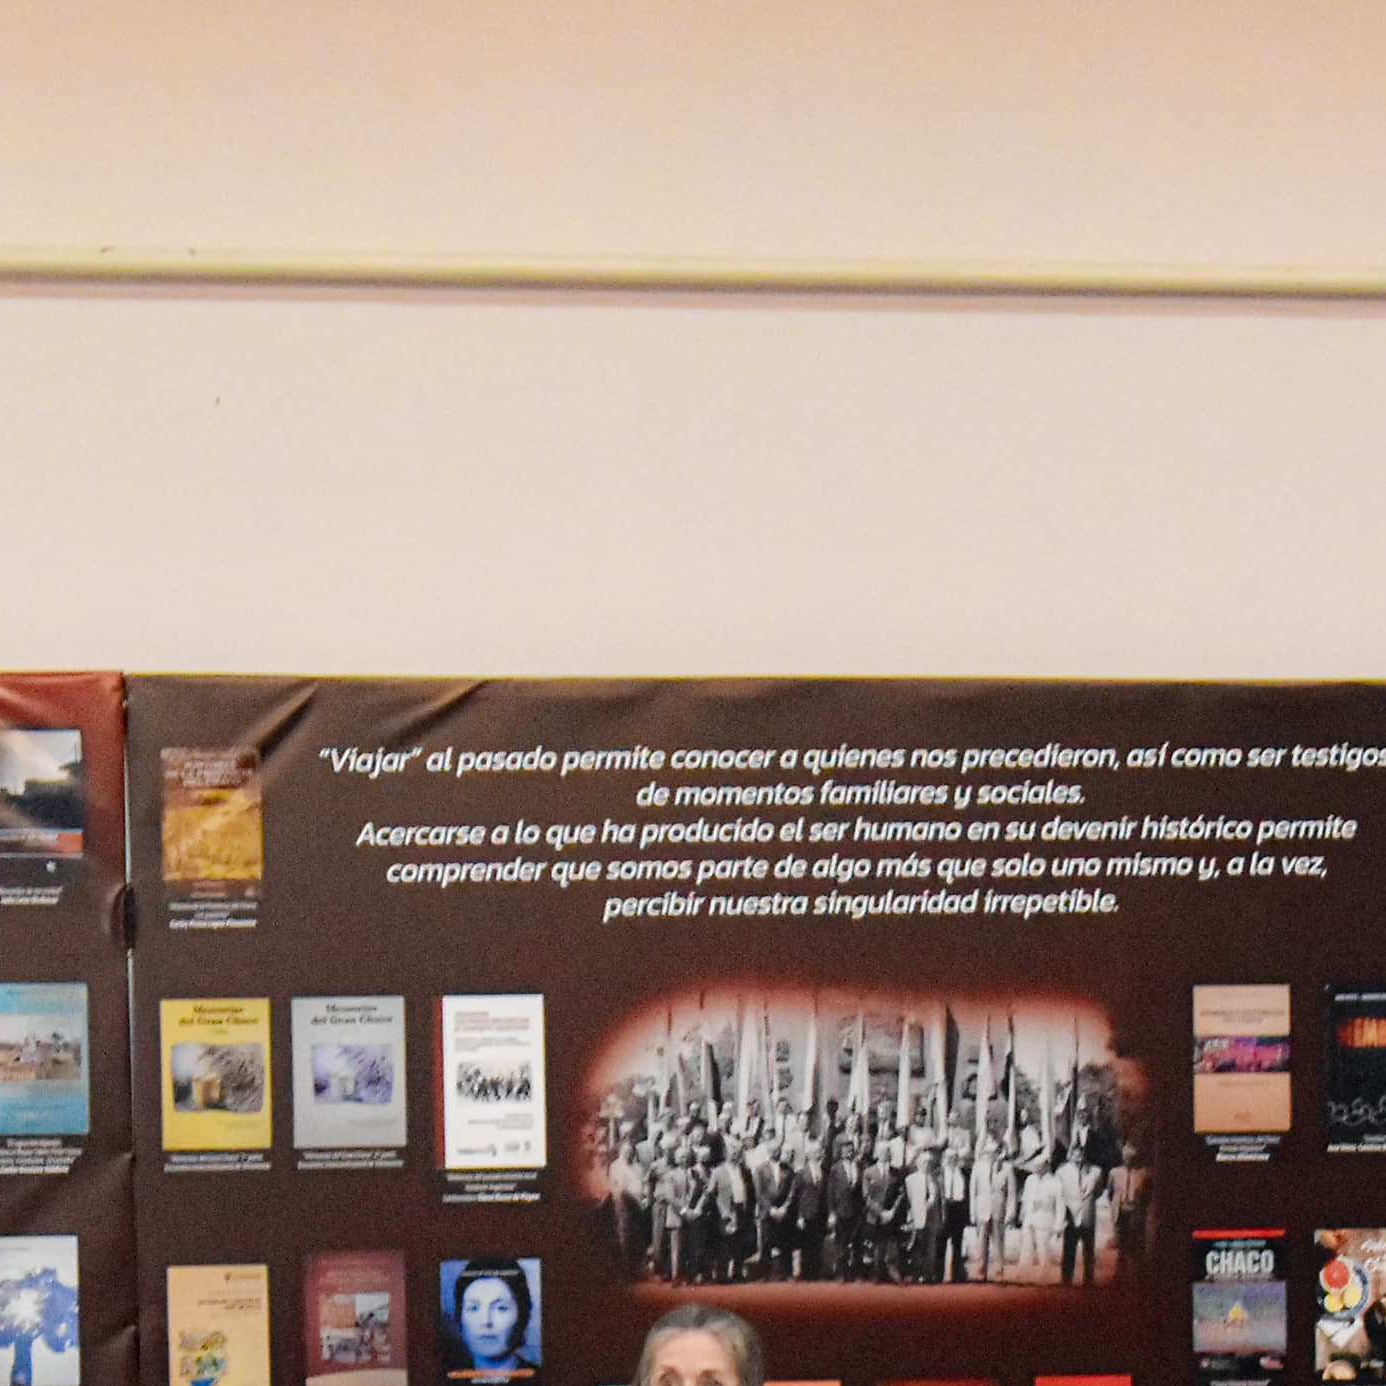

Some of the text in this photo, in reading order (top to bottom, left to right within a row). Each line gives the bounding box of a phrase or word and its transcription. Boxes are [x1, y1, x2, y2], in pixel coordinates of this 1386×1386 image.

[426, 747, 453, 771] al
[456, 745, 557, 778] pasado
[561, 745, 665, 776] permite
[671, 750, 776, 769] conocer
[780, 750, 798, 768] a
[803, 744, 905, 775] quienes
[911, 749, 957, 767] nos
[961, 743, 1119, 773] precedieron,
[1127, 742, 1169, 767] así
[1171, 748, 1242, 767] como
[1247, 748, 1287, 767] ser
[637, 779, 1085, 809] de momentos familiares y sociales.
[356, 815, 1357, 851] Acercarse a lo que ha producido el ser humano en su devenir histórico permite
[387, 851, 1327, 888] comprender que somos parte de algo más que solo uno mismo y, a la vez,
[603, 888, 1118, 923] percibir nuestra singularidad irrepetible.
[1205, 1249, 1275, 1276] CHACO
